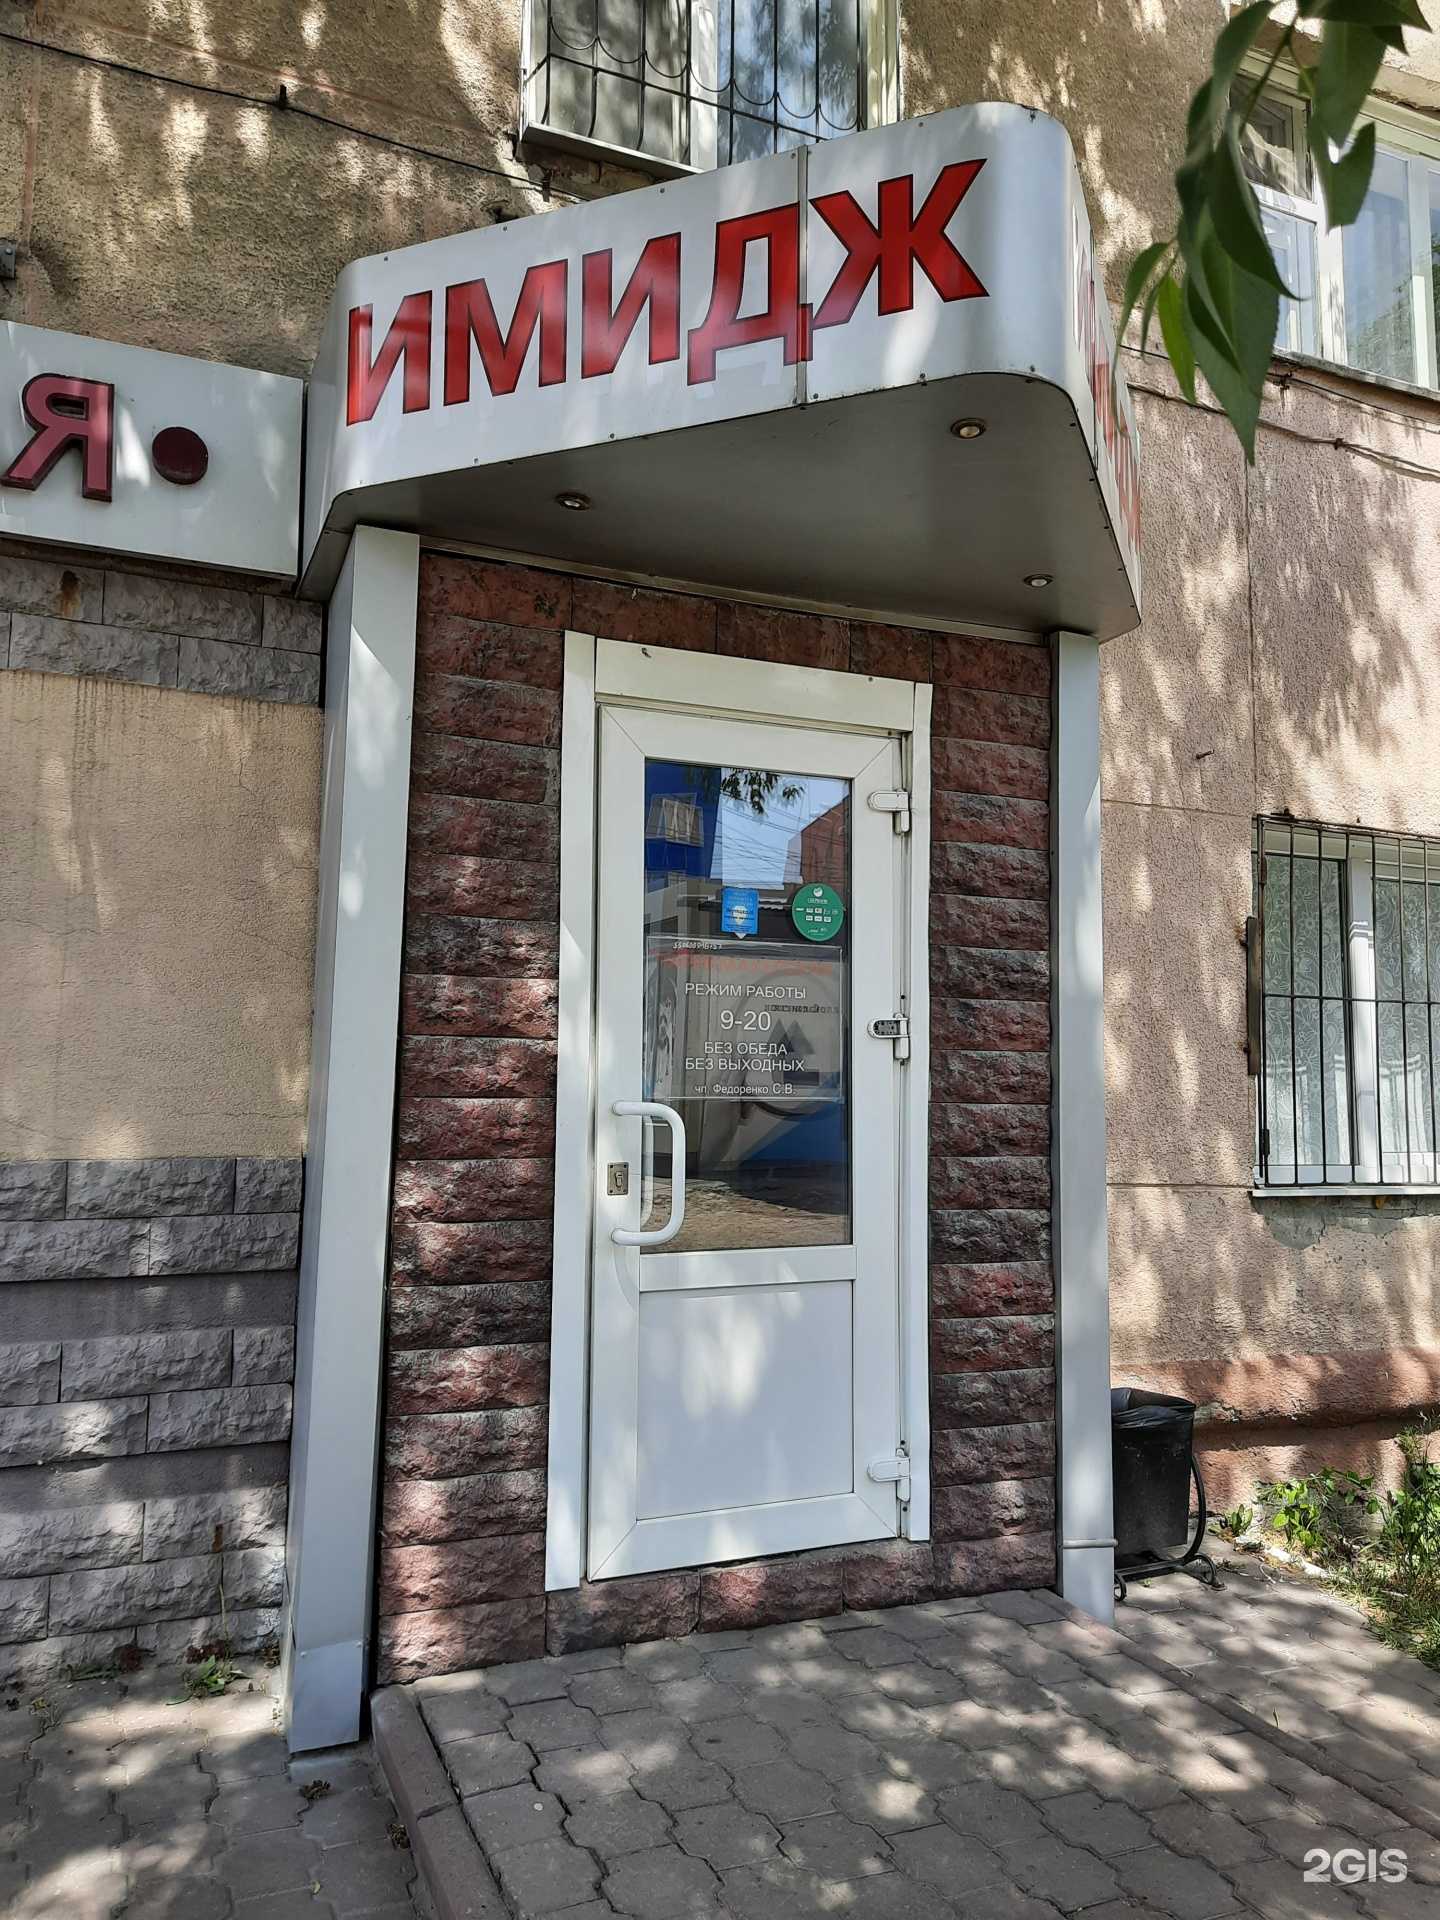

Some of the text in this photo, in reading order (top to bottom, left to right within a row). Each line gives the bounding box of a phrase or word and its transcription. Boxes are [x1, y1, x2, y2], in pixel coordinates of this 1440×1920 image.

[346, 158, 990, 427] ИМИДЖ
[685, 983, 806, 999] РЕЖИМ РАБОТЫ
[720, 1010, 771, 1031] 9-20
[704, 1042, 788, 1056] БЕЗ ОБЕДА
[685, 1057, 805, 1073] БЕЗ ВЫХОДНЫХ
[713, 1083, 769, 1096] Федоренко
